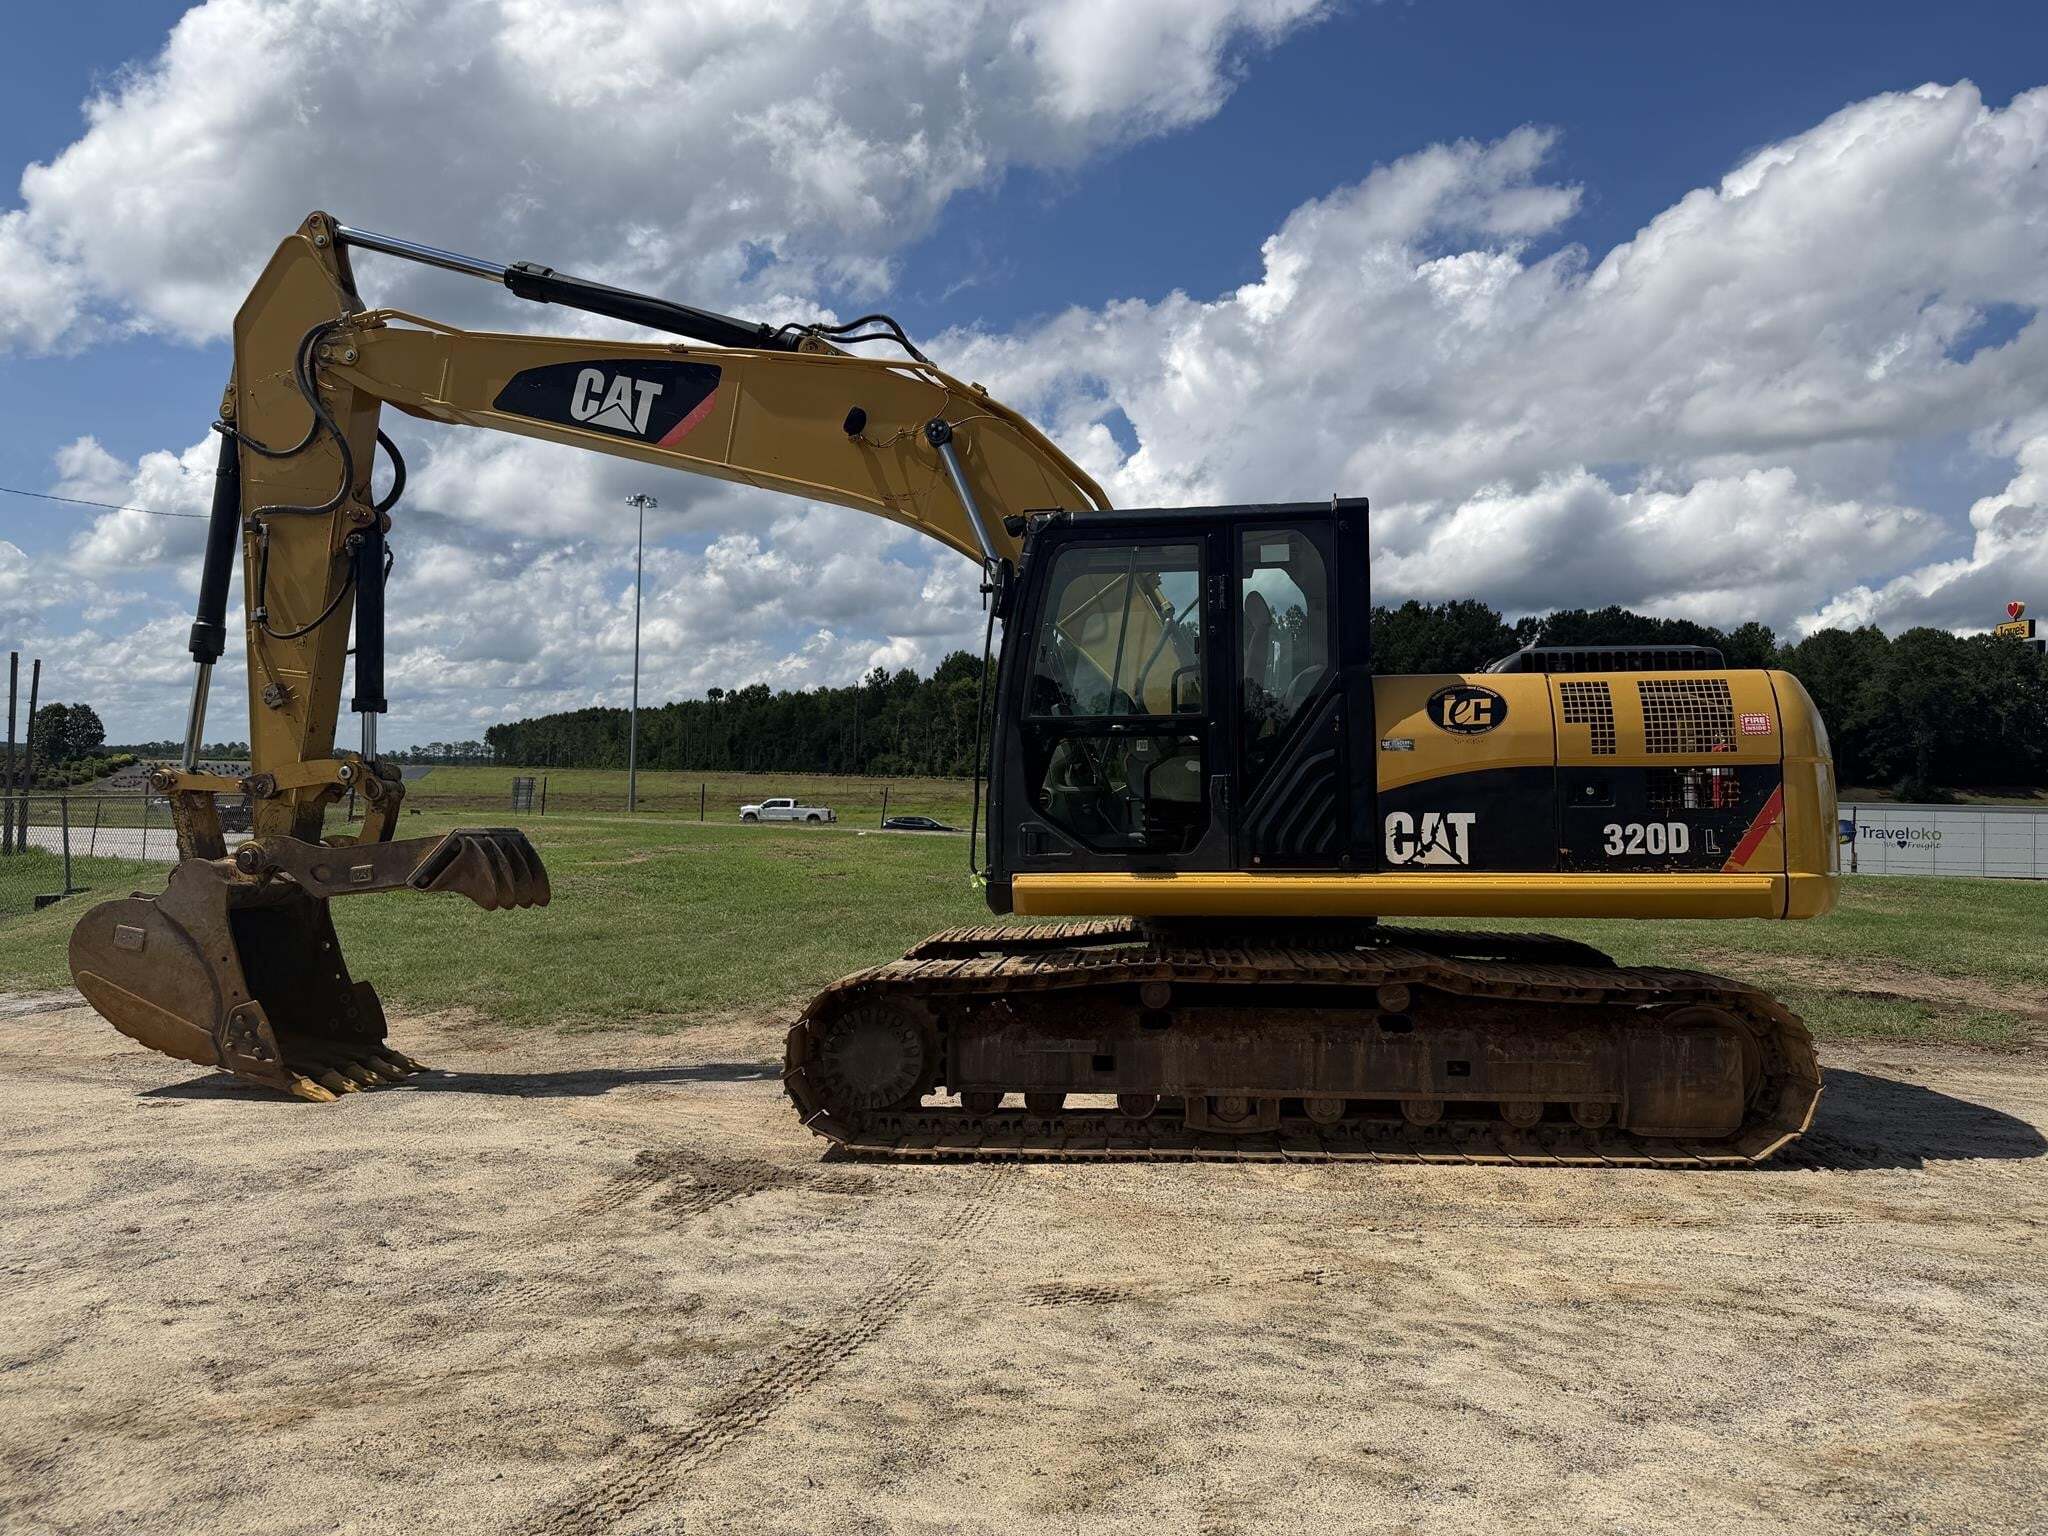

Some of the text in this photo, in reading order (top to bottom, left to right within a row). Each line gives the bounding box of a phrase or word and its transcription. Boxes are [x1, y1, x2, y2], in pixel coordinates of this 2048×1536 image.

[570, 368, 664, 435] CAT
[1744, 716, 1766, 724] FIRE
[1385, 811, 1476, 865] CAT
[1603, 822, 1721, 856] 320D L
[1859, 825, 1942, 841] Traveloko
